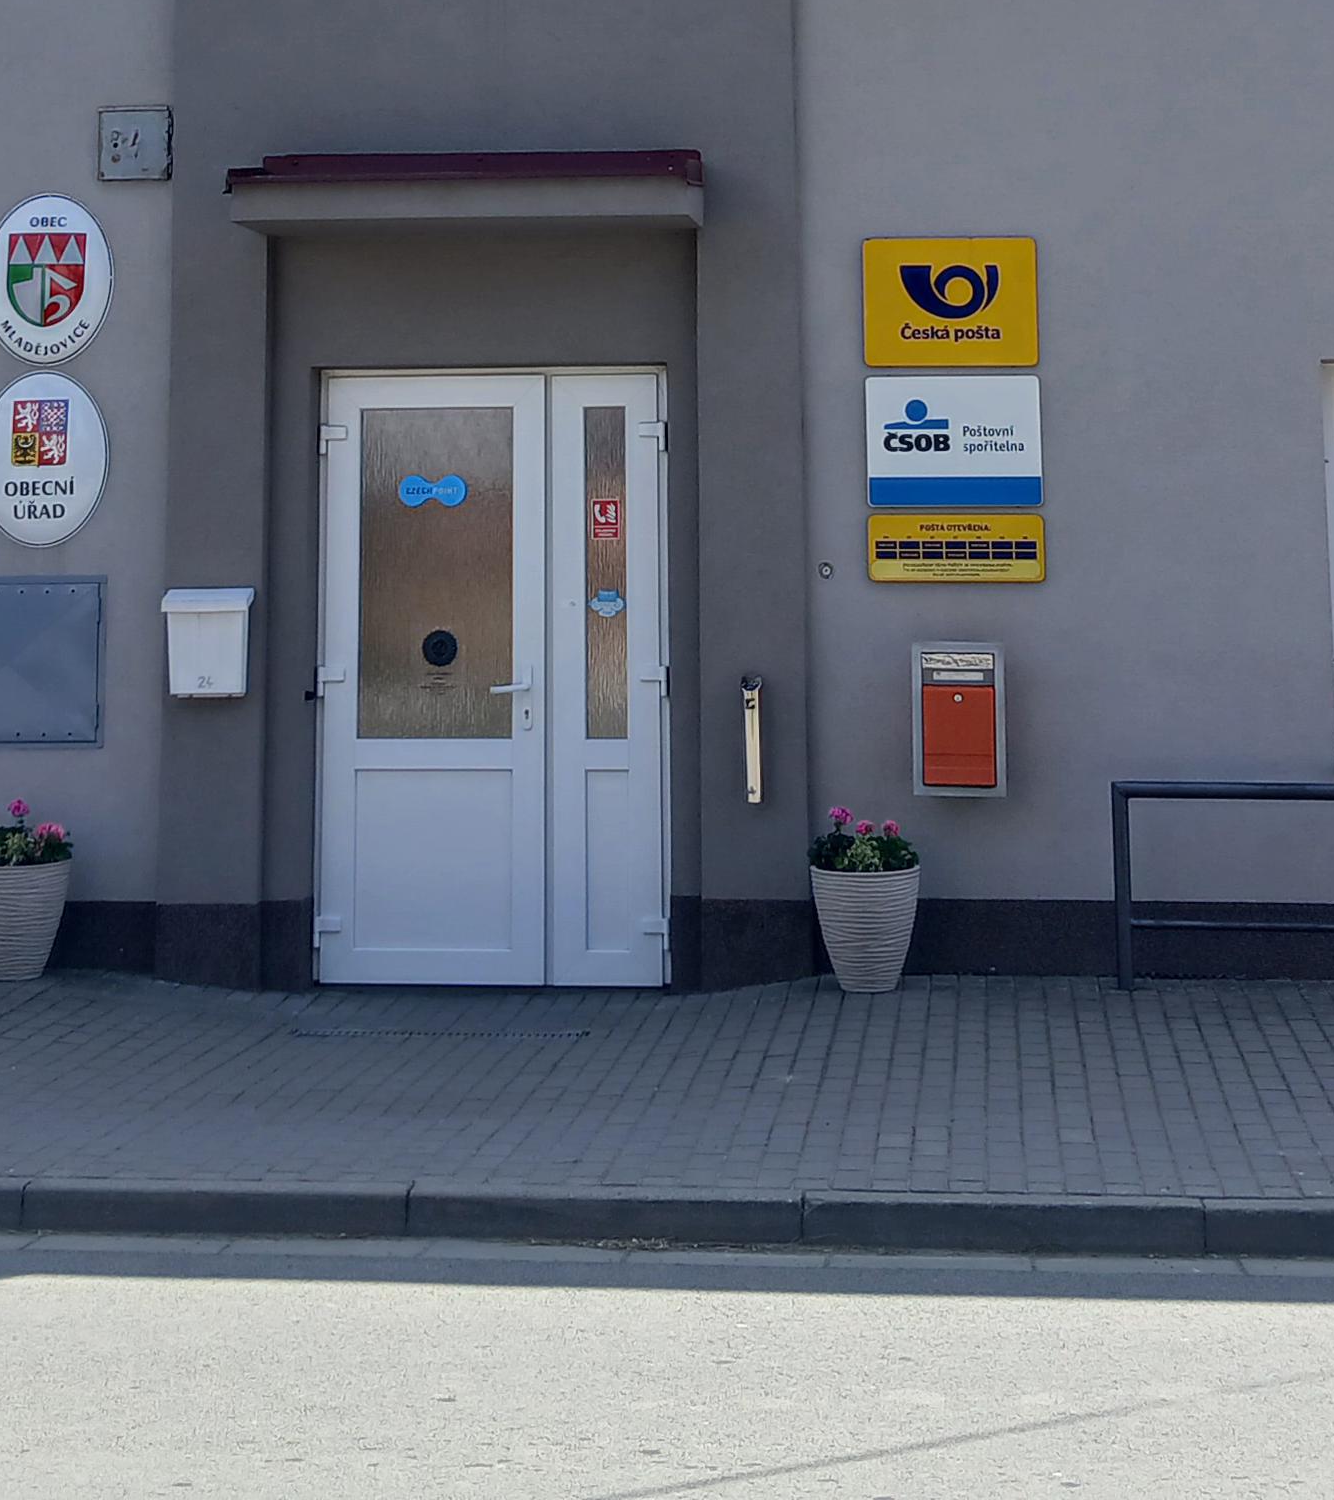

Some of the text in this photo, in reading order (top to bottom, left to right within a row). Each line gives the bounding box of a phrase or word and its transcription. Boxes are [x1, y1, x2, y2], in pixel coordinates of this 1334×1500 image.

[29, 216, 67, 228] OBEC
[0, 319, 90, 357] MLADĚJOVICE
[900, 322, 1001, 342] Česká pošta
[962, 425, 1014, 437] Poštovní
[884, 431, 951, 452] ČSOB
[963, 440, 1025, 454] spořitelna
[4, 474, 74, 497] OBECNÍ
[13, 500, 66, 520] ÚŘAD
[919, 523, 946, 532] POŠTA
[197, 675, 214, 689] 24
